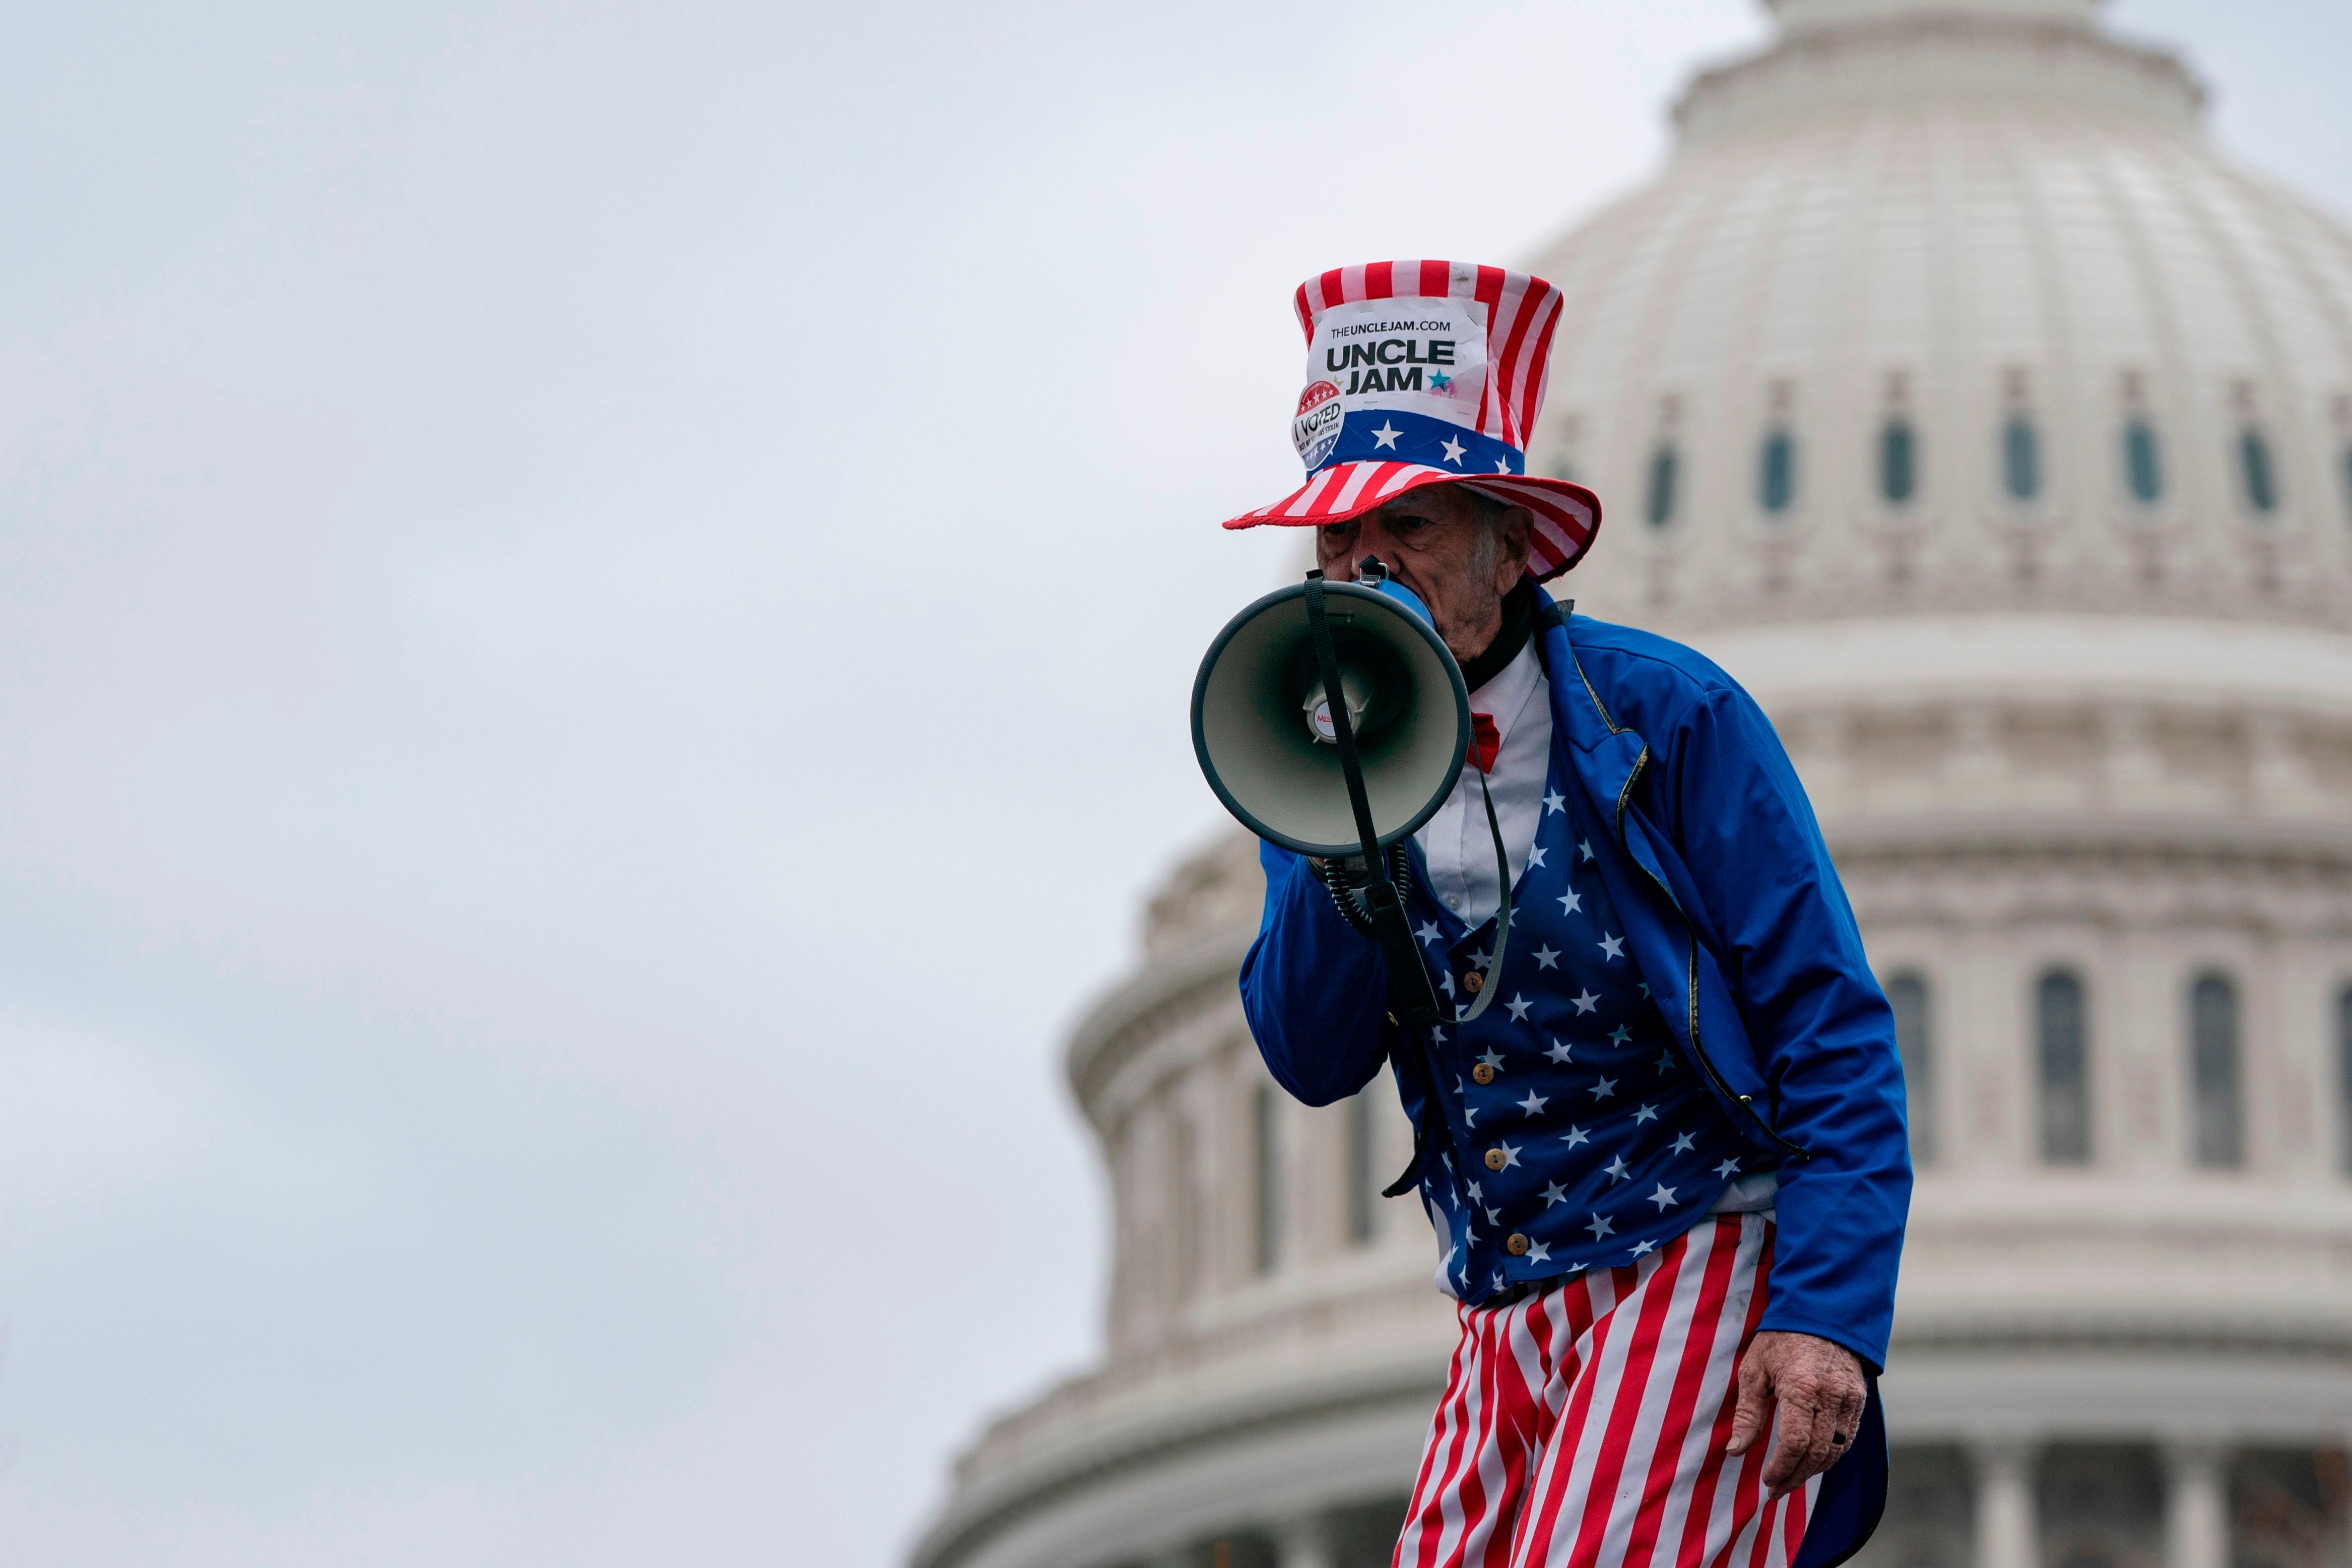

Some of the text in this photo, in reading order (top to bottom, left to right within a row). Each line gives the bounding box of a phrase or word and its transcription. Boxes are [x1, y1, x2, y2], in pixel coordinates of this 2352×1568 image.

[1331, 321, 1450, 339] THEUNCLEJAM.COM
[1327, 339, 1455, 372] UNCLE
[1346, 367, 1422, 396] JAM
[1295, 403, 1341, 441] I VOTED
[1305, 438, 1311, 446] MY
[1325, 422, 1339, 433] STOLEN
